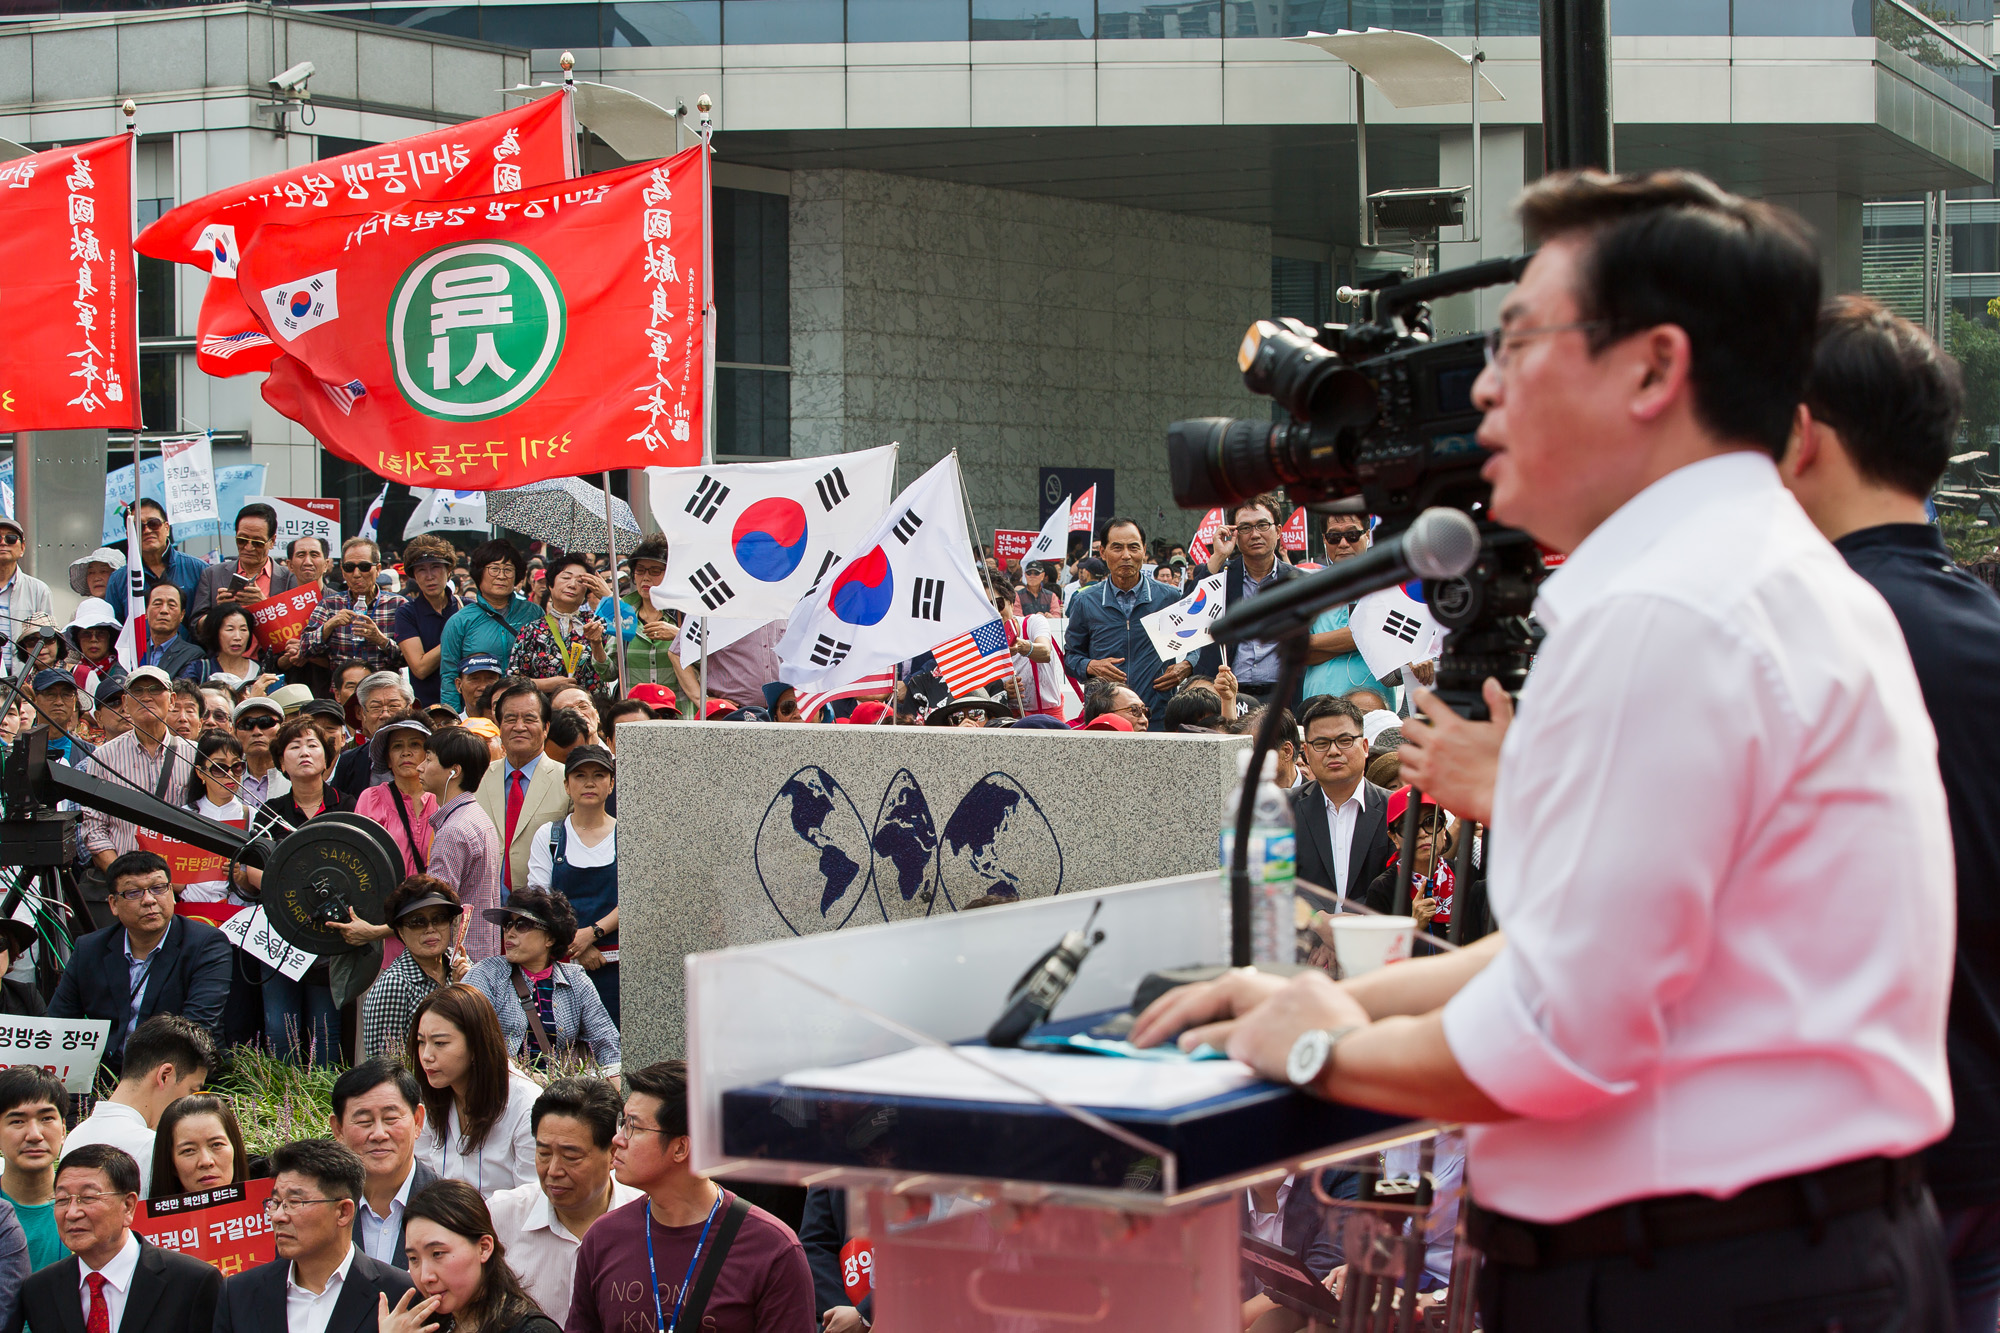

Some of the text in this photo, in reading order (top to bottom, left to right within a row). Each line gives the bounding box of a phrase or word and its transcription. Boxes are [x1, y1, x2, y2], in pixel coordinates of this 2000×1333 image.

[285, 519, 331, 537] 민경욱
[1281, 530, 1304, 543] 경산시
[996, 545, 1026, 556] 국민에게
[291, 589, 319, 611] 장악
[268, 617, 310, 645] STOP
[320, 846, 372, 892] SAMSUNG
[284, 890, 336, 934] BARBLL
[62, 1030, 100, 1051] 장악
[155, 1198, 180, 1212] 5천만
[212, 1187, 239, 1202] 만드는
[610, 1281, 644, 1303] NO
[652, 1283, 695, 1306] ON
